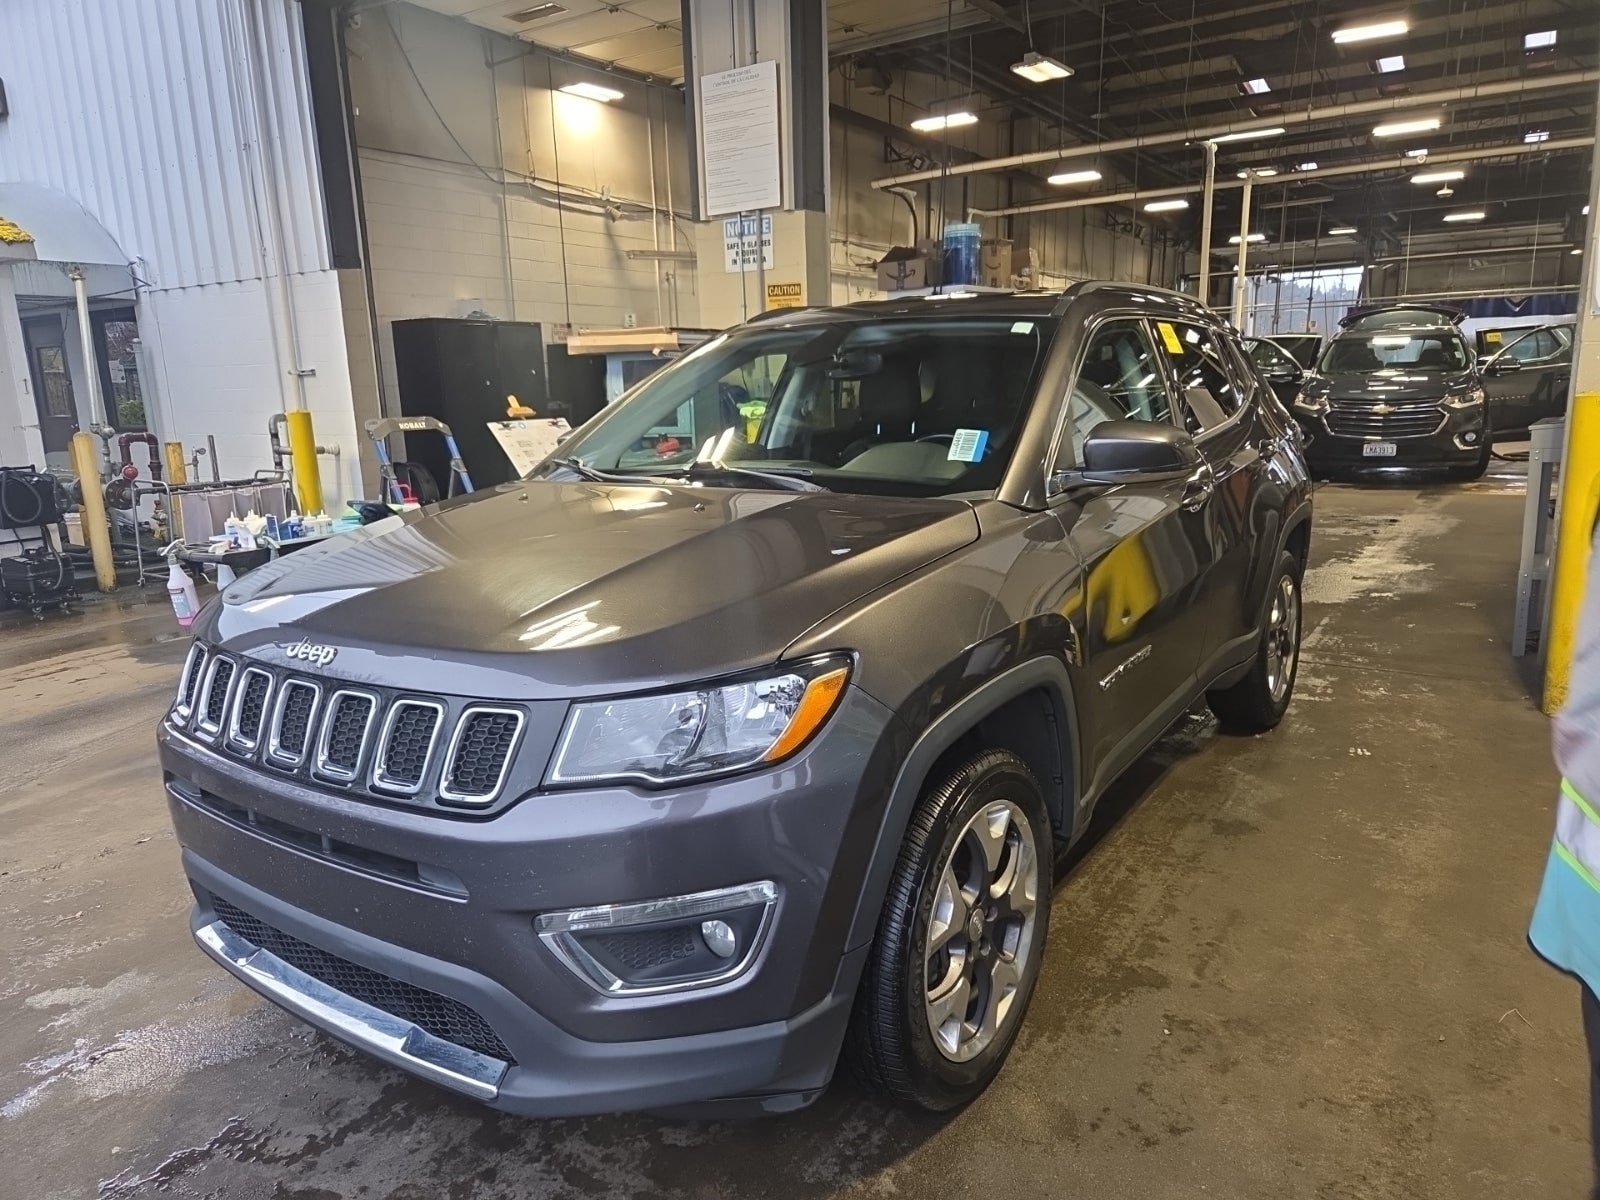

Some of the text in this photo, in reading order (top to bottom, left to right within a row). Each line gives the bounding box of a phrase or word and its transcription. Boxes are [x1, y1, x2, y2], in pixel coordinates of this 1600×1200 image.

[727, 239, 771, 250] SAFEY GLASES
[768, 285, 800, 296] CAUTION
[398, 421, 426, 430] KOBALT
[286, 636, 336, 668] Jeep
